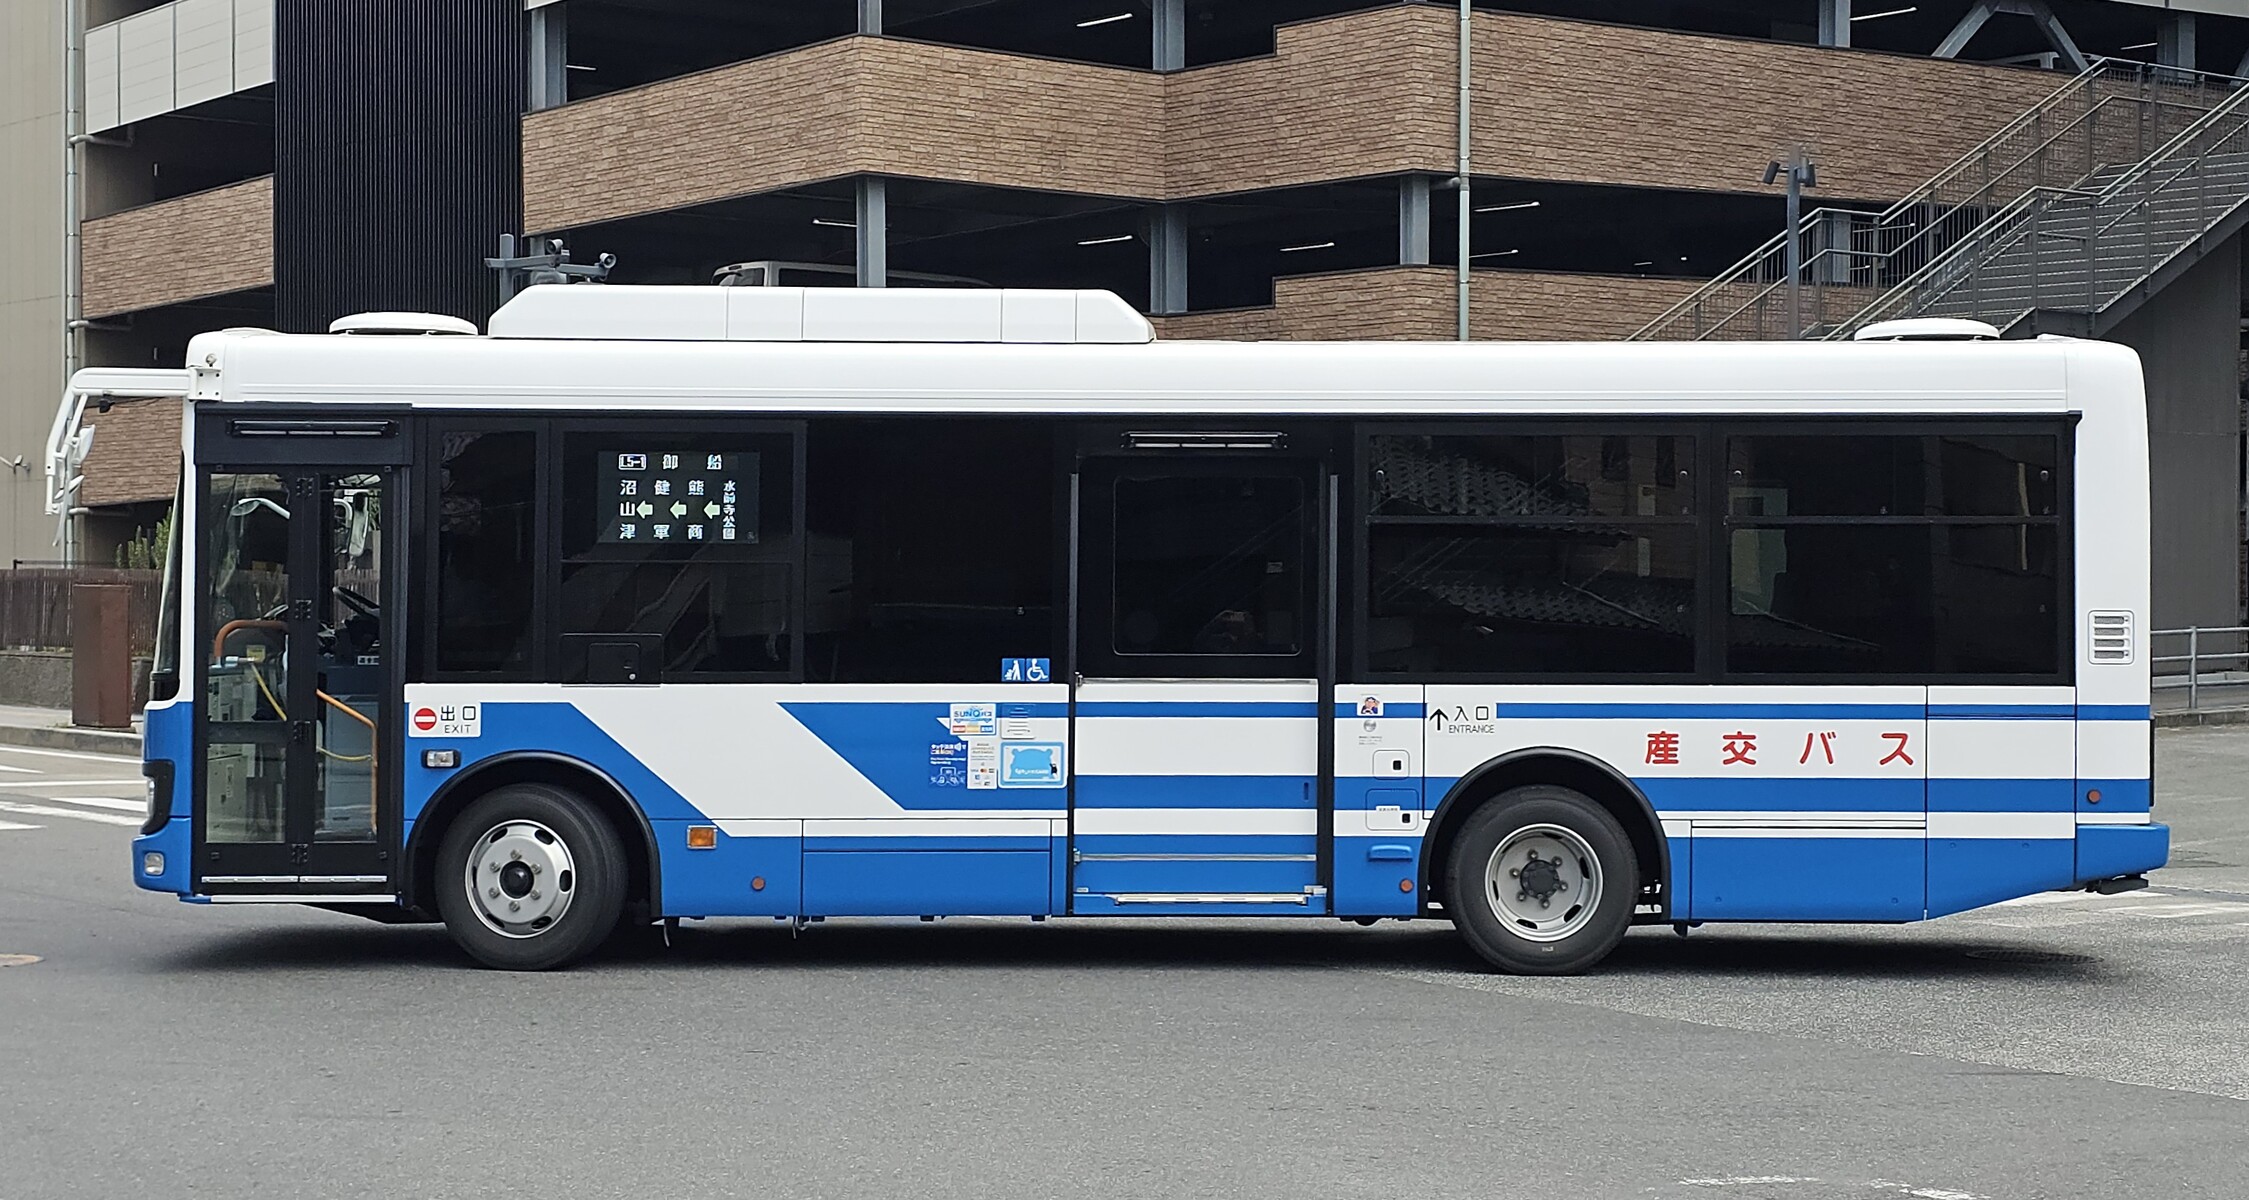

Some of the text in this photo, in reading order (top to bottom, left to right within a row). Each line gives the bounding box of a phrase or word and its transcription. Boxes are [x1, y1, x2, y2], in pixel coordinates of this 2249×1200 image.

[620, 455, 646, 469] L5-1
[662, 454, 722, 470] 御船
[619, 479, 637, 540] 沼山津
[653, 479, 671, 540] 健軍
[687, 480, 705, 540] 熊商
[722, 480, 736, 540] 水前寺公園
[440, 705, 476, 721] 出口
[1454, 706, 1489, 721] 入口
[444, 724, 472, 733] EXIT
[1449, 724, 1495, 734] ENTRANCE
[1645, 731, 1914, 765] 産交バス
